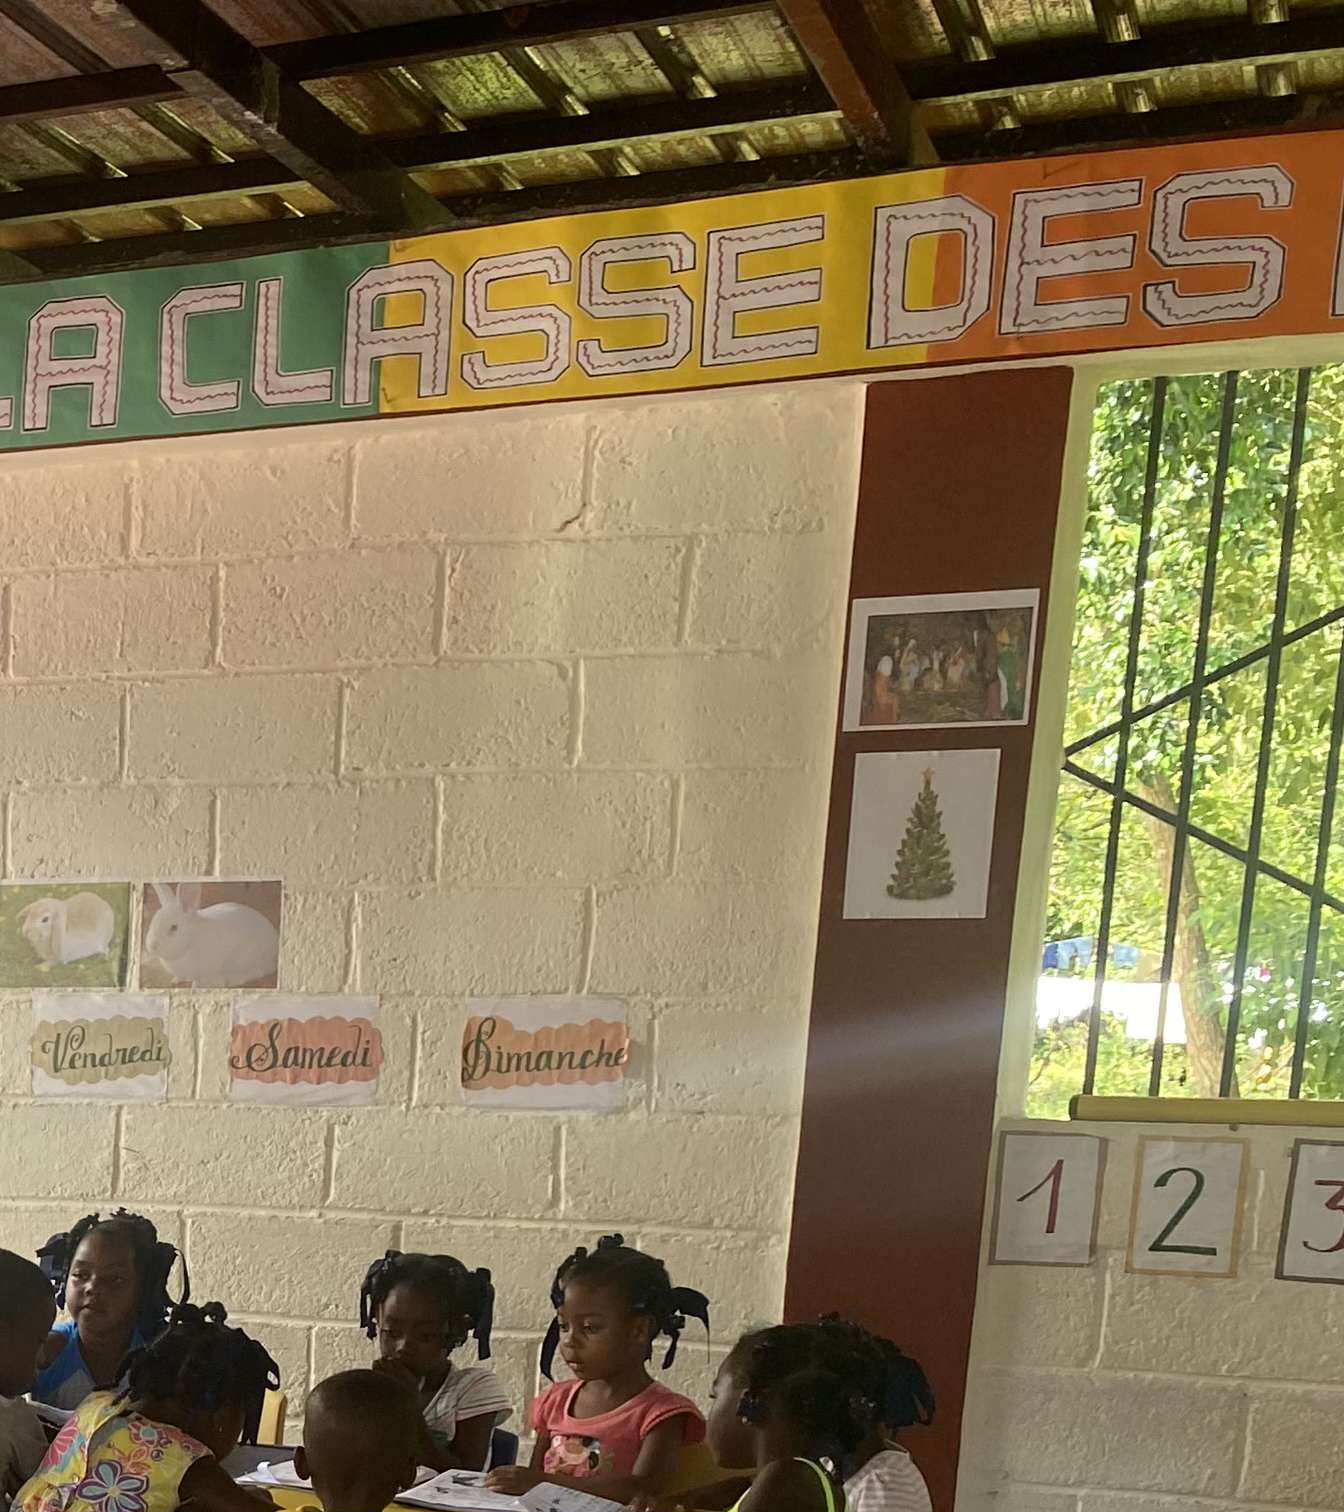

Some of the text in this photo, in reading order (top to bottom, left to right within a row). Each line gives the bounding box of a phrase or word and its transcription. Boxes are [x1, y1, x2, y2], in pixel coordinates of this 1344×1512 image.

[159, 215, 825, 415] CLASSE
[867, 164, 1295, 350] DES
[40, 1025, 167, 1074] Vendredi
[230, 1022, 373, 1073] Samedi
[461, 1016, 627, 1083] Dimanche
[1016, 1158, 1064, 1234] 1
[1148, 1166, 1217, 1256] 2
